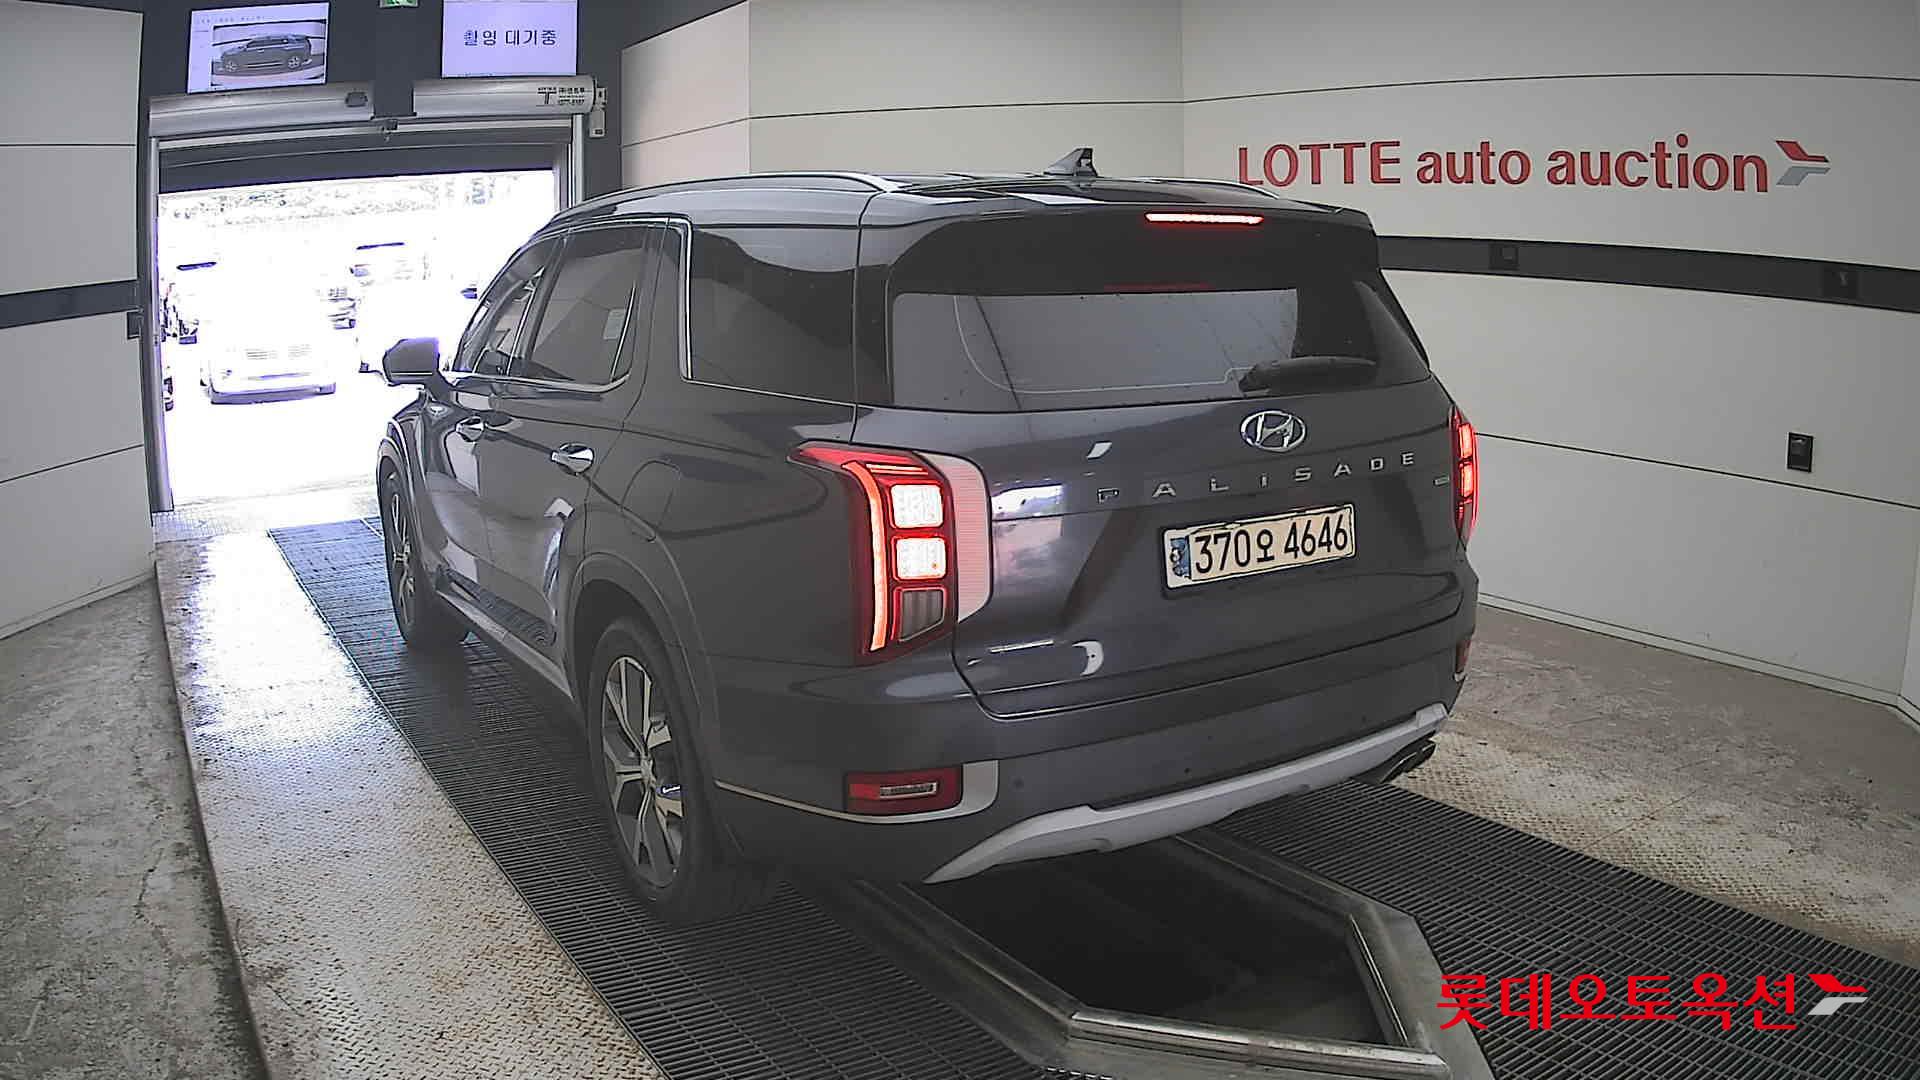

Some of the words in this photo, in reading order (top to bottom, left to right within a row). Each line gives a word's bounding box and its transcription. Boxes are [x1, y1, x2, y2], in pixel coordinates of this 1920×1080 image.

[505, 29, 557, 47] 대기중
[1238, 140, 1401, 187] LOTTE
[1416, 140, 1532, 185] auto
[1547, 133, 1769, 193] auction
[1097, 452, 1416, 503] PALISADE
[1195, 529, 1275, 574] 370오
[1284, 513, 1348, 559] 4646
